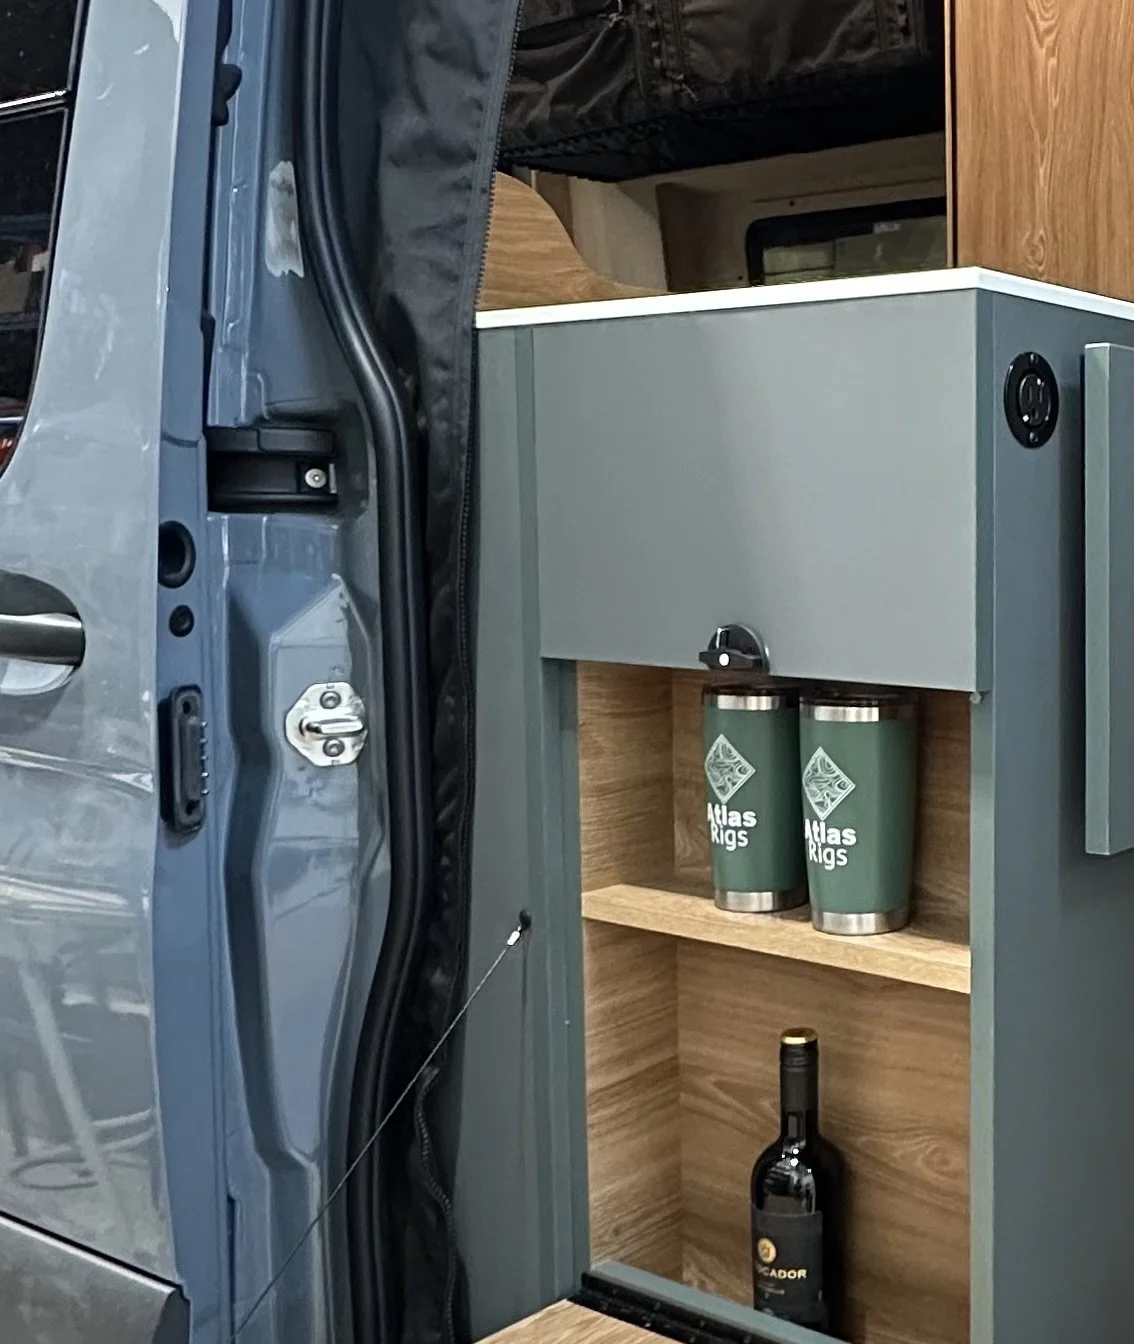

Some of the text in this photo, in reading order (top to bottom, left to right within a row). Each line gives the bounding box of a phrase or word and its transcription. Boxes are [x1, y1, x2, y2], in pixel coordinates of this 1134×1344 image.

[706, 802, 758, 828] Atlas
[710, 822, 749, 852] Rigs
[804, 818, 857, 846] Atlas
[807, 838, 848, 871] Rigs
